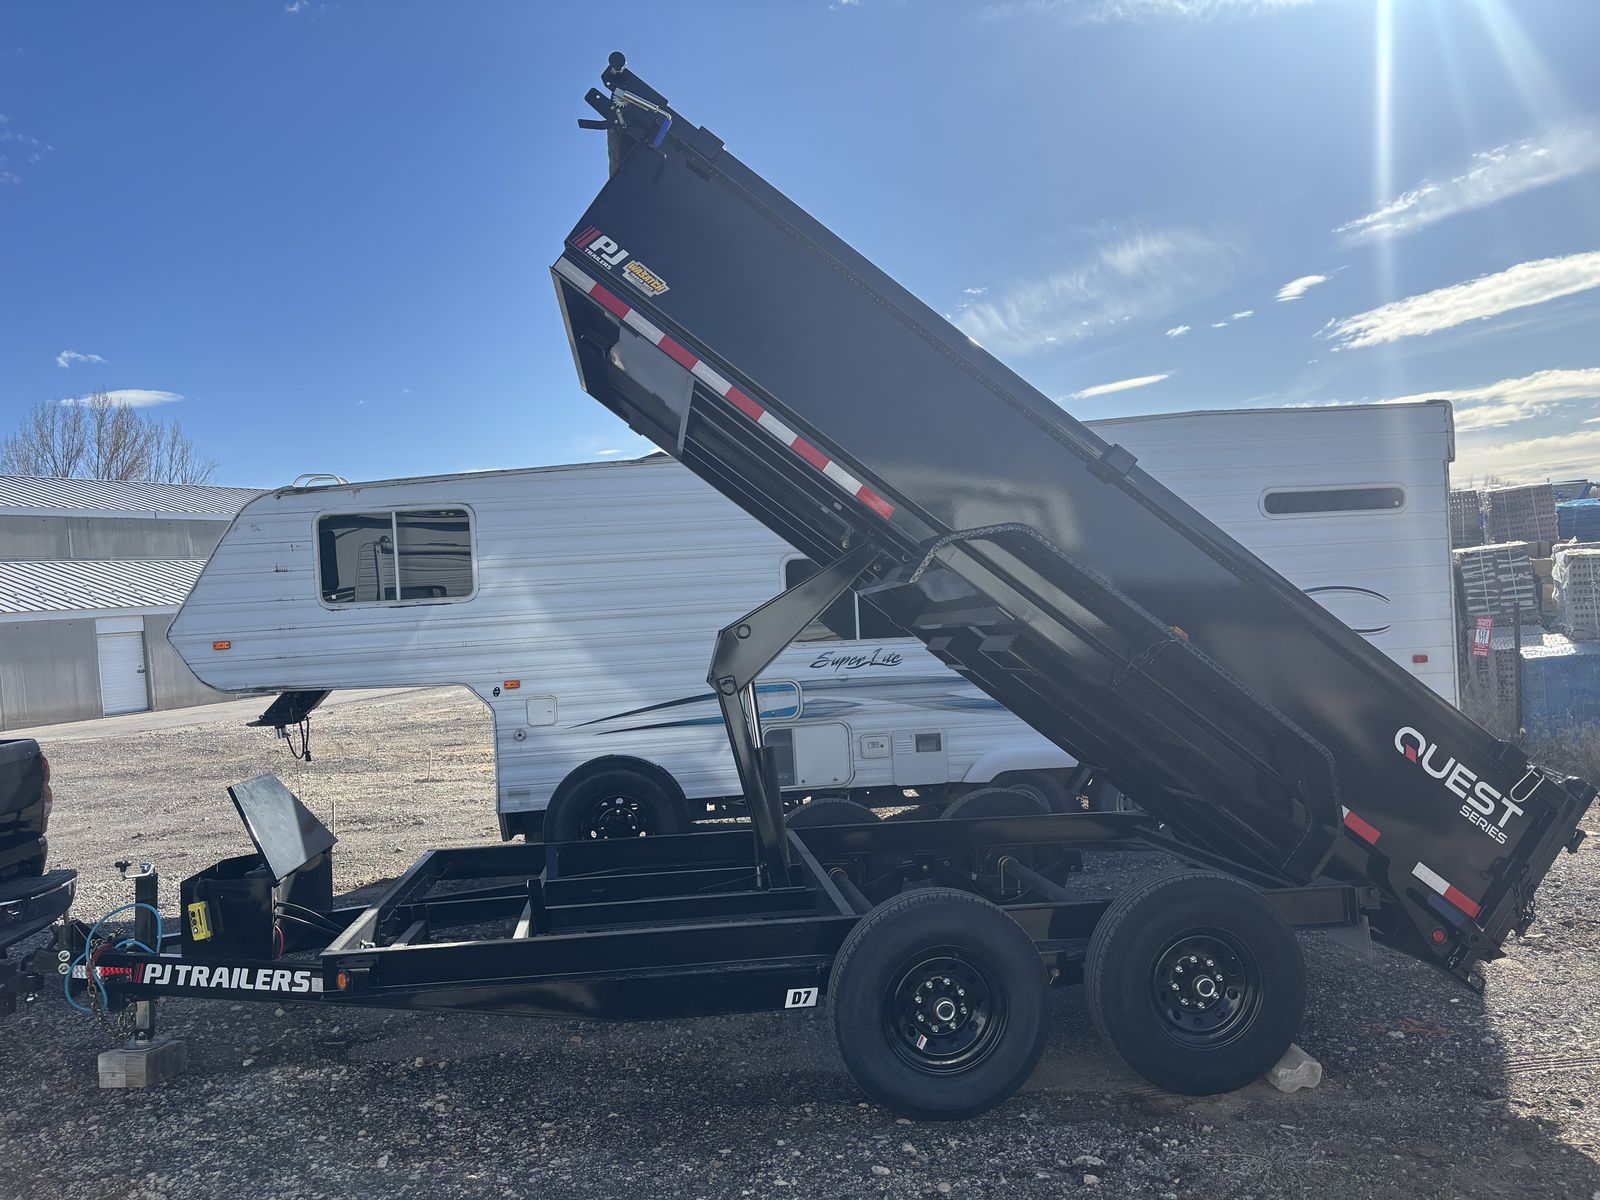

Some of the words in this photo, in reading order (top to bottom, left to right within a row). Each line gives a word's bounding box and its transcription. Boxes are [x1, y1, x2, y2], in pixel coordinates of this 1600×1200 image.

[584, 248, 613, 270] TRAILERS
[588, 235, 630, 266] PJ
[627, 263, 666, 292] WASATCH
[1394, 726, 1524, 828] QUEST
[1459, 805, 1508, 844] SERIES
[143, 963, 173, 985] PJ
[175, 965, 311, 992] TRAILERS
[791, 990, 812, 1005] D7
